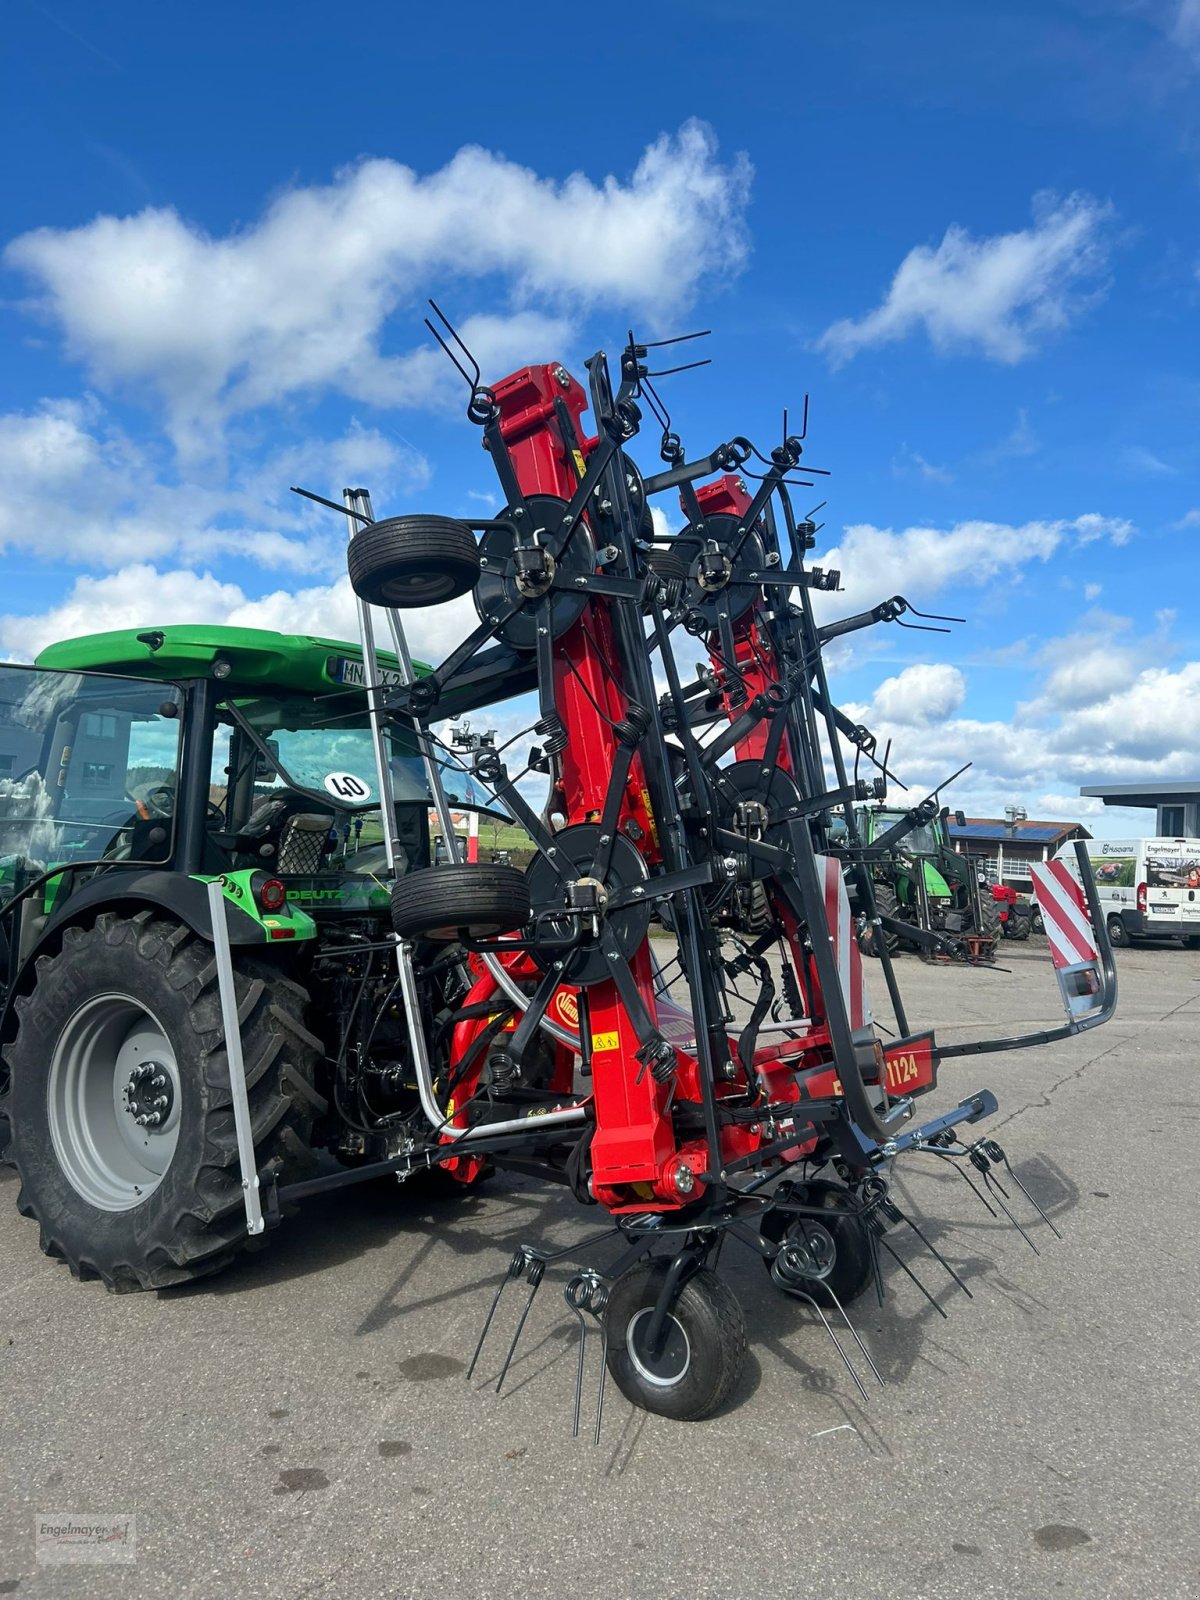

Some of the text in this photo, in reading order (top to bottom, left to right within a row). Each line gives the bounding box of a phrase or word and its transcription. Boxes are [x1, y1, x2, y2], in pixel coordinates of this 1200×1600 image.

[344, 661, 364, 684] MN
[331, 776, 365, 797] 40
[1147, 845, 1180, 854] Engelmayer
[886, 1054, 918, 1087] 1124
